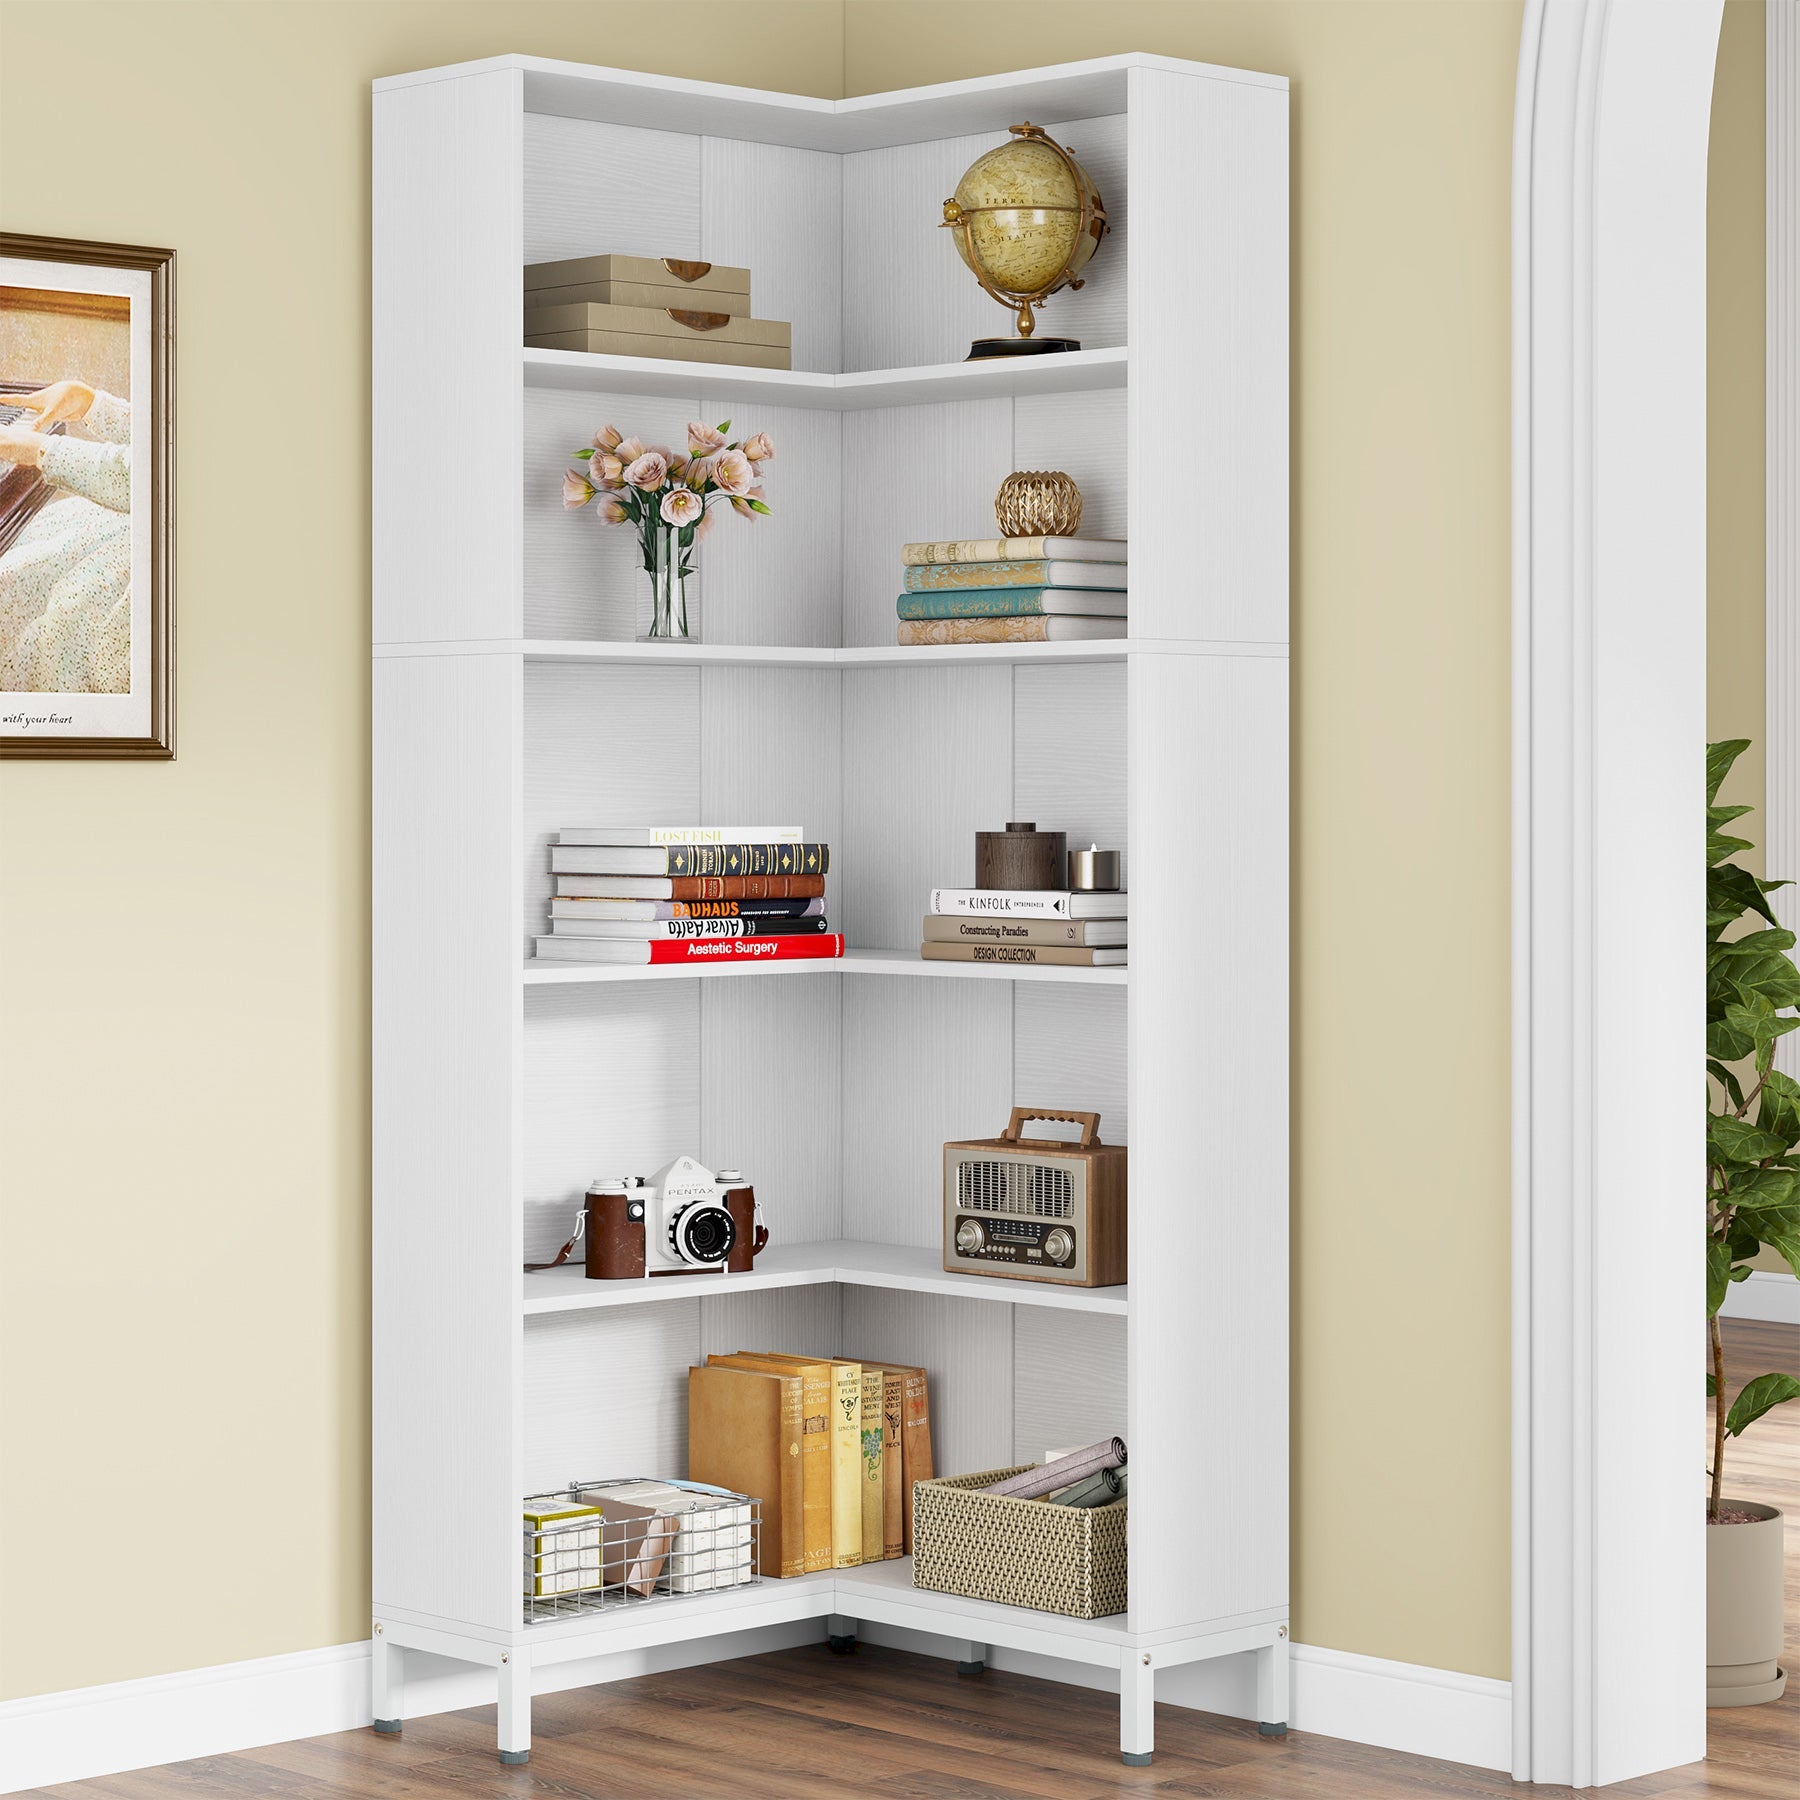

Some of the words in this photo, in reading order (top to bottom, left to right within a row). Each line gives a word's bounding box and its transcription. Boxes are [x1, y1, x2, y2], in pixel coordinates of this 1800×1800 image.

[2, 712, 24, 723] with
[22, 716, 47, 729] your
[48, 713, 73, 724] heart
[655, 831, 688, 842] LOST
[691, 831, 721, 842] FISH
[672, 901, 740, 918] BAUHAUS
[969, 896, 1012, 911] KINFOLK
[668, 920, 704, 938] Aalto
[705, 919, 740, 937] Alvar
[960, 924, 1001, 938] Constructing
[1001, 925, 1029, 937] Paradies
[687, 942, 733, 956] Aestetic
[735, 941, 779, 956] Surgery
[973, 947, 997, 960] DESIGN
[997, 948, 1037, 961] COLLECTION
[668, 1187, 714, 1196] PENTAX
